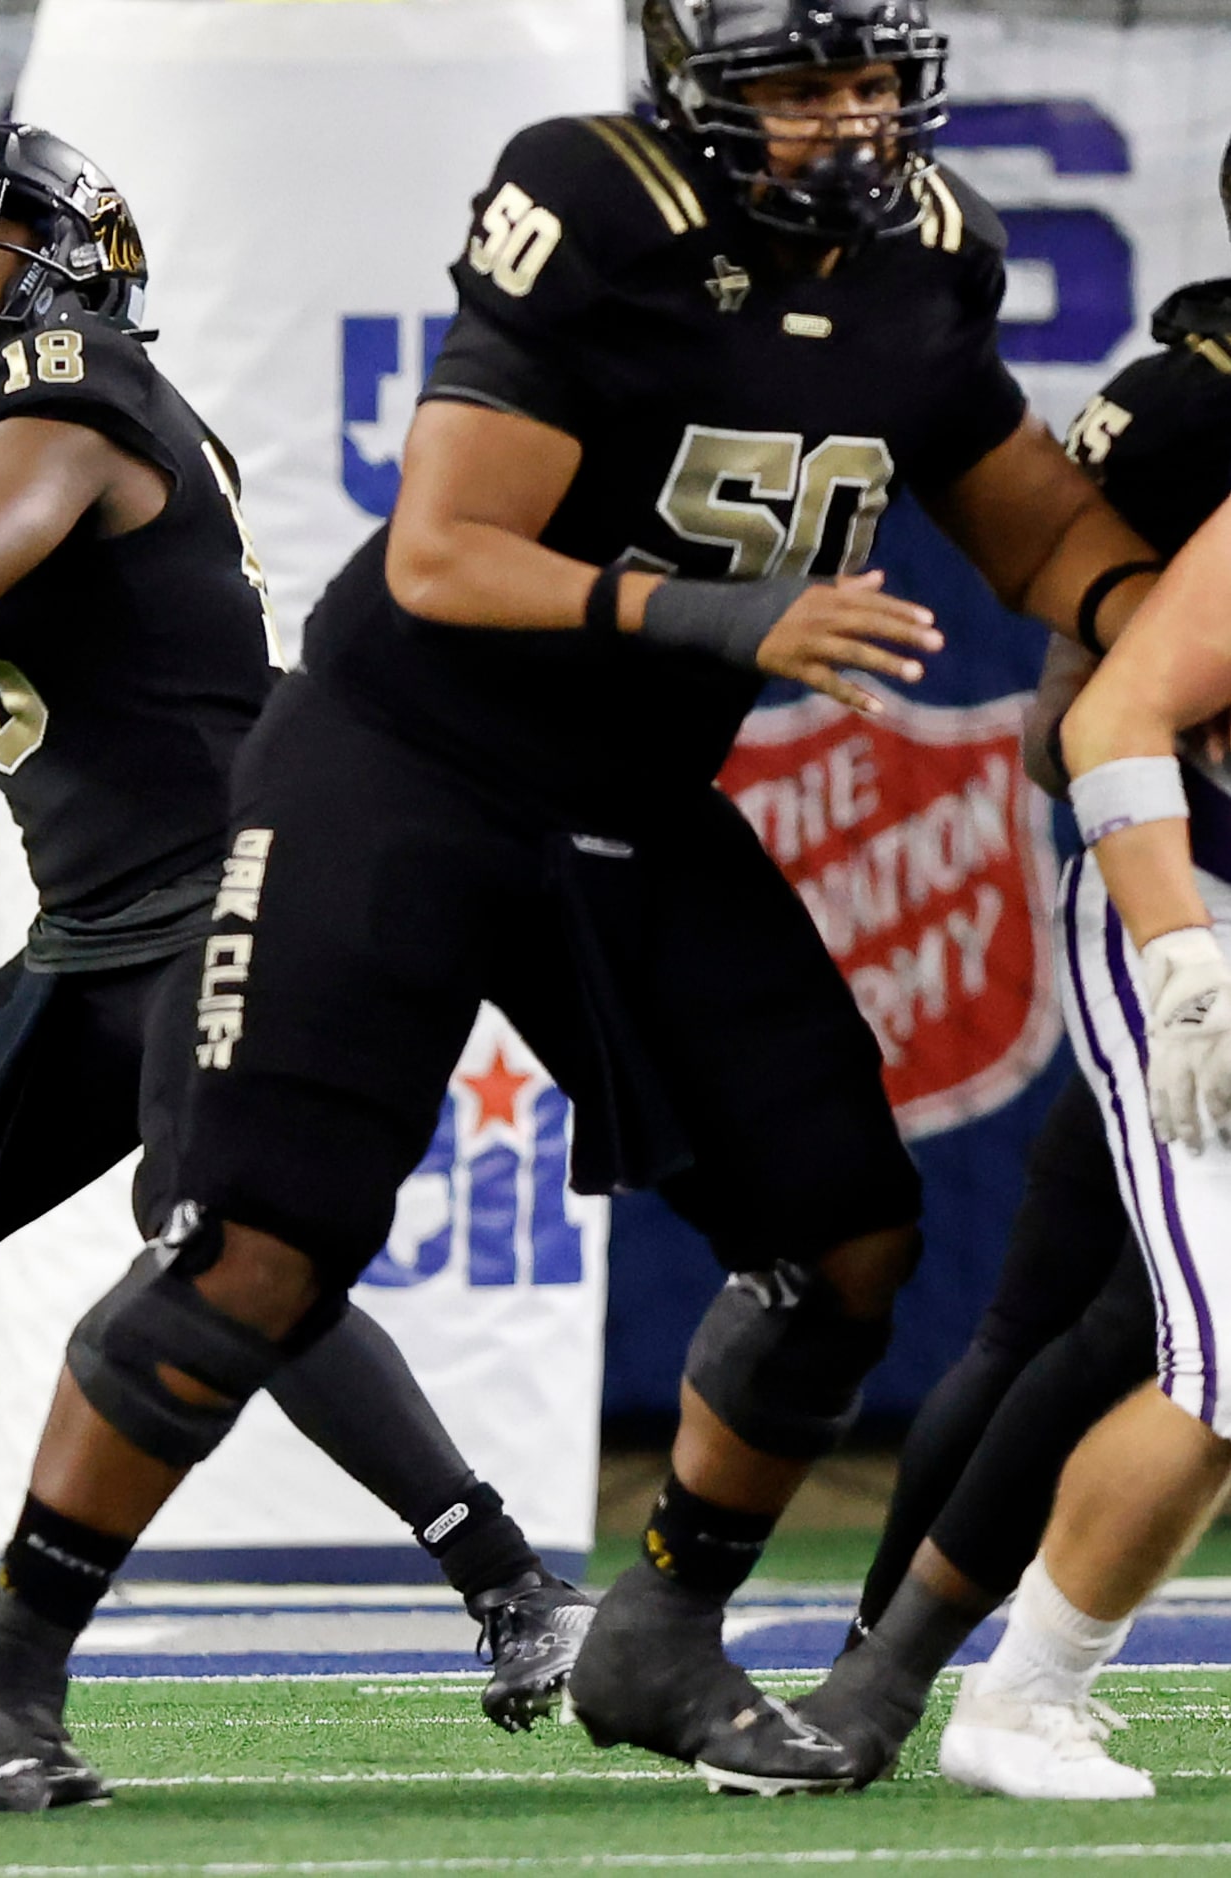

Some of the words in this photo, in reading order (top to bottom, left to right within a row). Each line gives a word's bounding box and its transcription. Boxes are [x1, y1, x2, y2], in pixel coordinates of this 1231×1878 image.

[469, 180, 562, 297] 50
[1, 329, 84, 395] 18
[617, 423, 895, 578] 50
[734, 736, 880, 864] THE
[211, 828, 274, 922] OAK
[195, 933, 254, 1070] CLIFF
[852, 884, 1003, 1067] RMY
